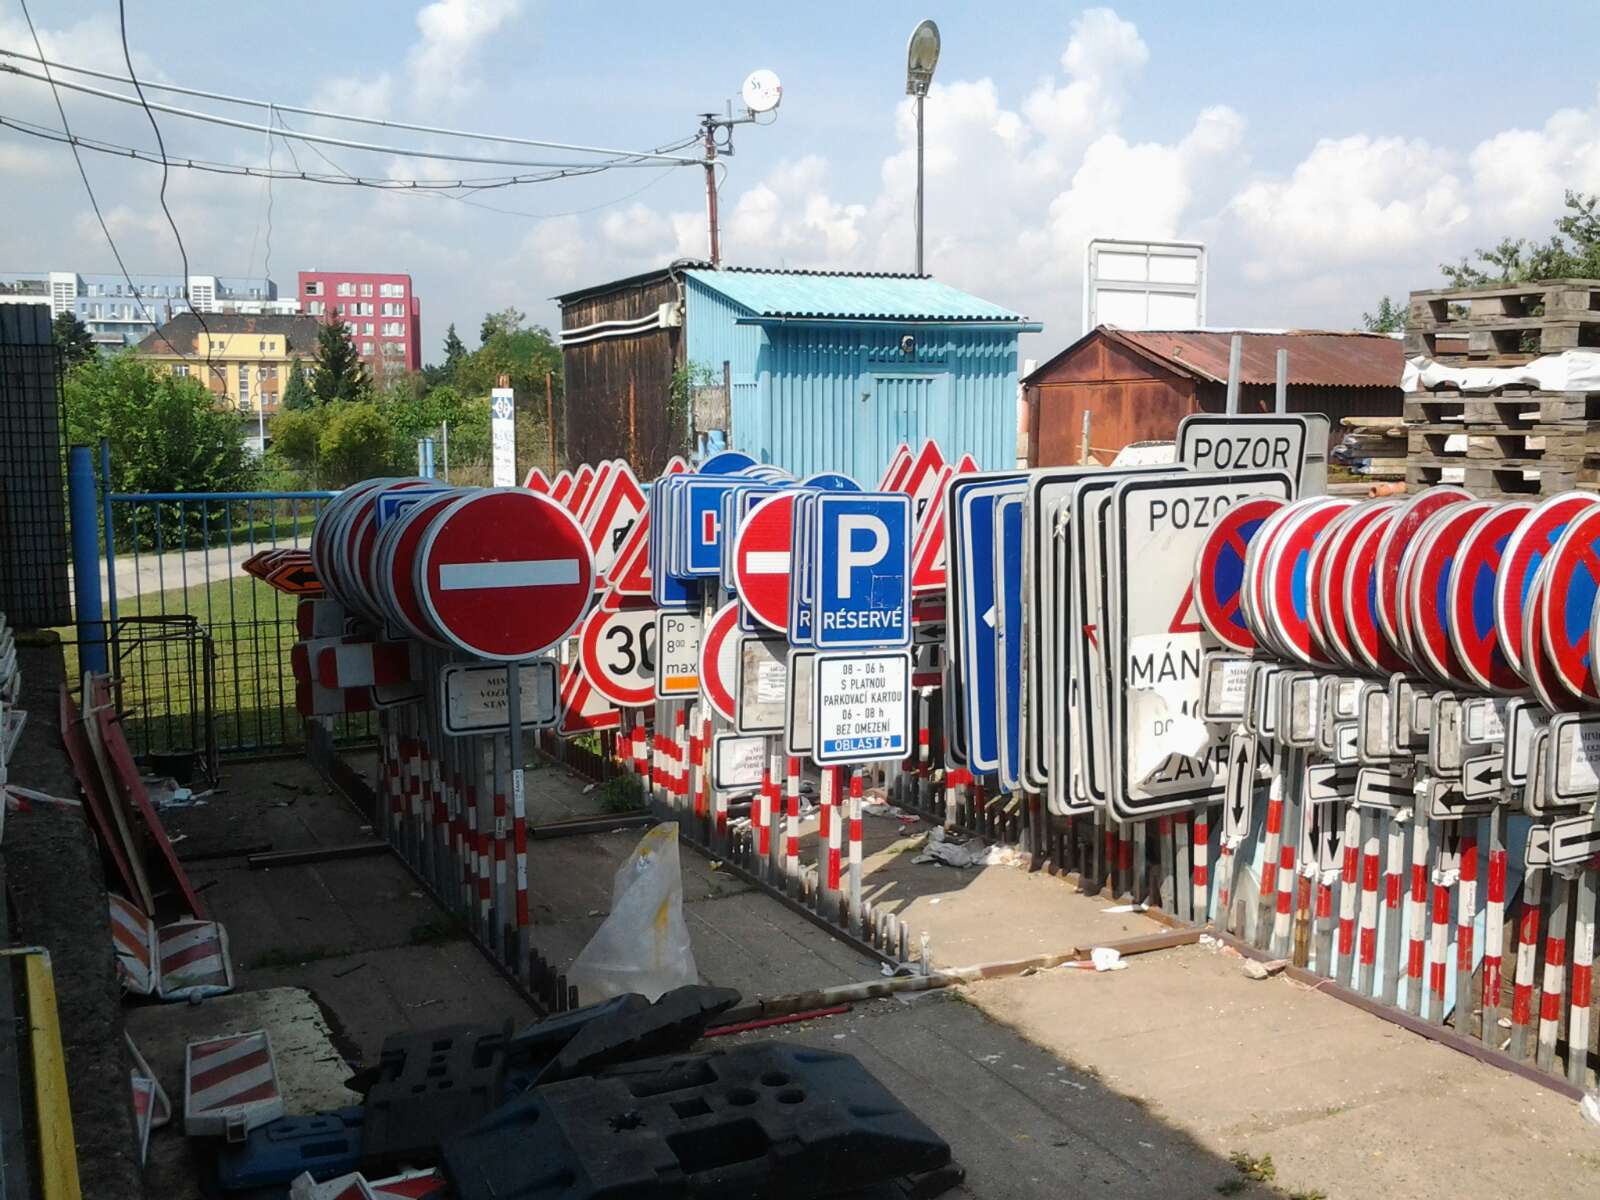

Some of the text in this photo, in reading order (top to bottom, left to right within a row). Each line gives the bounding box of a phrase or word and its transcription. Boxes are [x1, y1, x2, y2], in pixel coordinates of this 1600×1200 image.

[1194, 437, 1290, 470] POZOR
[1150, 494, 1250, 532] POZO
[837, 513, 890, 599] P
[823, 606, 903, 630] RÉSERVÉ
[666, 619, 685, 633] Po
[666, 663, 697, 674] max
[842, 664, 853, 675] 08
[865, 663, 876, 674] 06
[879, 662, 885, 673] h
[841, 678, 886, 690] S PLATNOU
[823, 691, 903, 707] PARKOVACÍ KARTOU
[842, 709, 852, 720] 06
[865, 708, 875, 719] 08
[878, 707, 884, 718] h
[836, 718, 891, 736] BEZ OMEZENÍ
[834, 737, 890, 752] OBLAST 7
